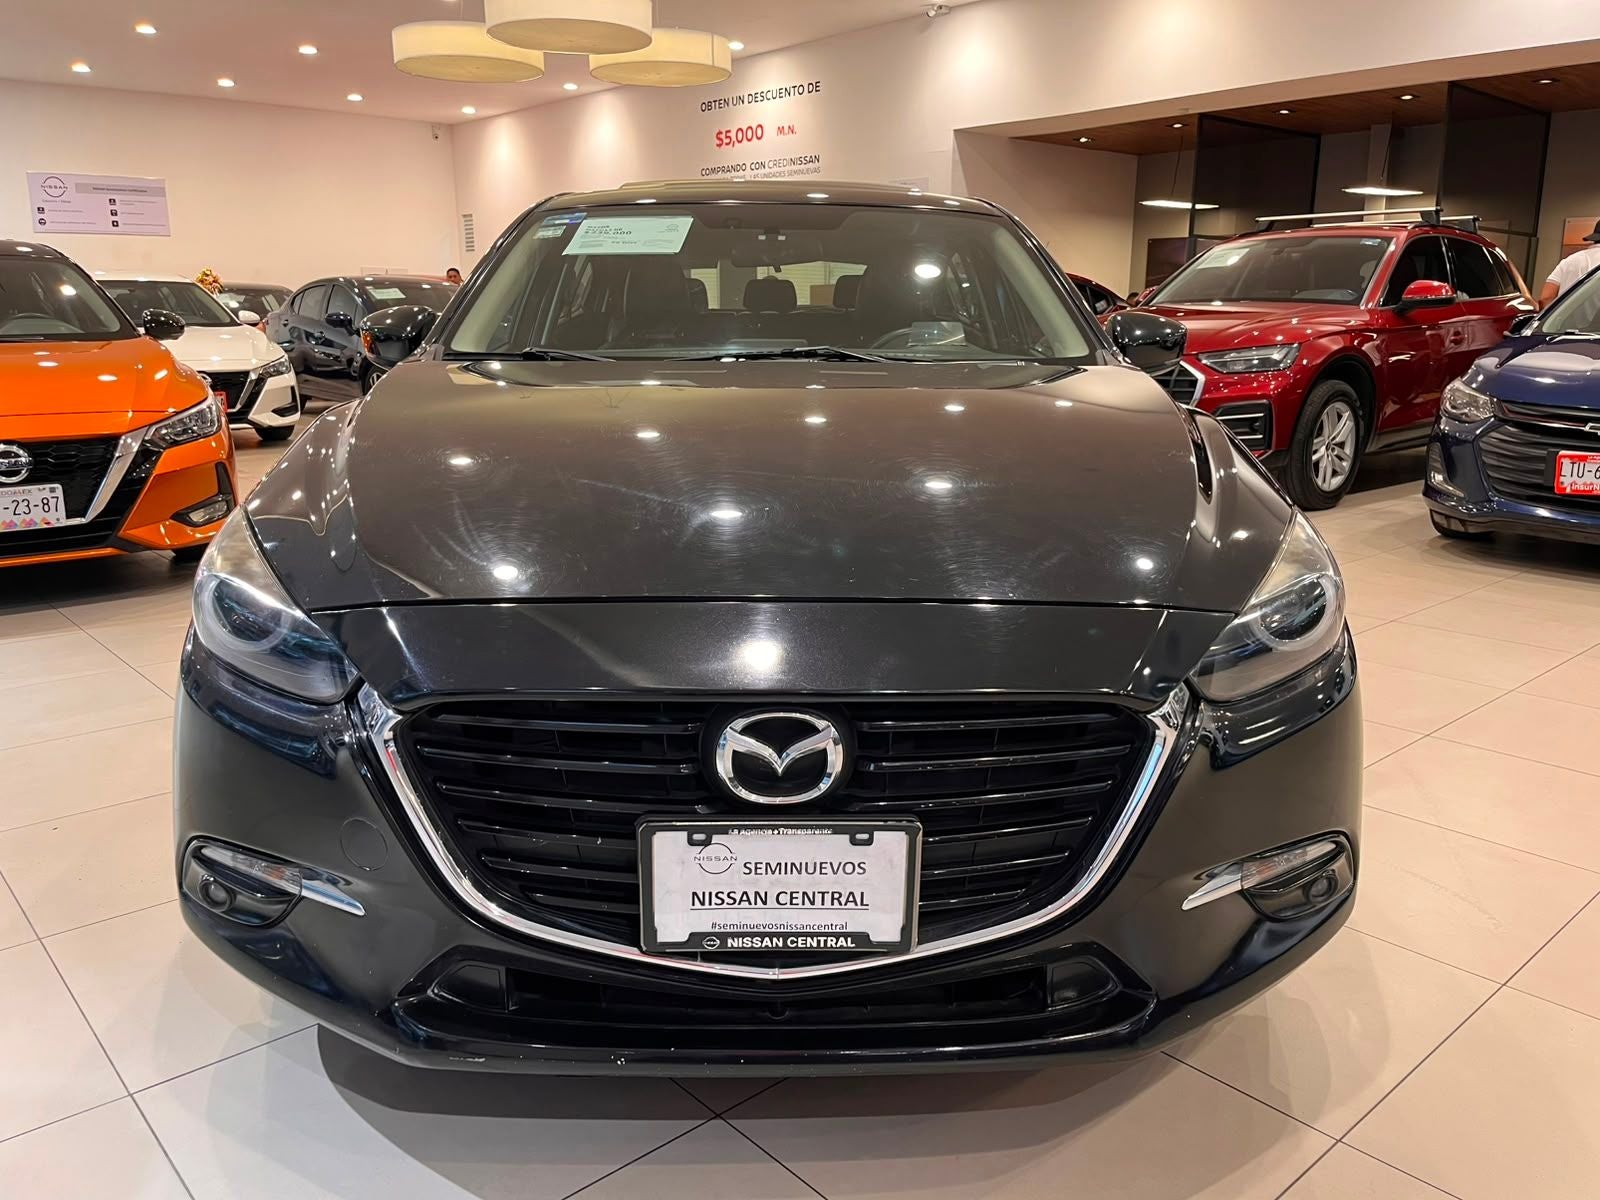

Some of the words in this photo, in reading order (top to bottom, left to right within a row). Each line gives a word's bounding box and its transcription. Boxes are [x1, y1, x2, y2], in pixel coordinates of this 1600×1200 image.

[700, 97, 730, 113] OBTEN
[732, 94, 745, 107] UN
[747, 84, 805, 105] DESCUENTO
[807, 81, 821, 94] DE
[715, 123, 764, 149] $5,000
[776, 124, 797, 137] M.N.
[700, 163, 747, 177] COMPRANDO
[749, 161, 766, 171] CON
[767, 154, 820, 169] CREDINISSAN
[787, 166, 821, 177] SEMINUEVAS
[742, 861, 867, 876] SEMINUEVOS
[691, 890, 768, 907] NISSAN
[775, 890, 869, 907] CENTRAL
[711, 921, 848, 931] #seminuevosnissancentral
[727, 936, 784, 948] NISSAN
[787, 936, 856, 948] CENTRAL
